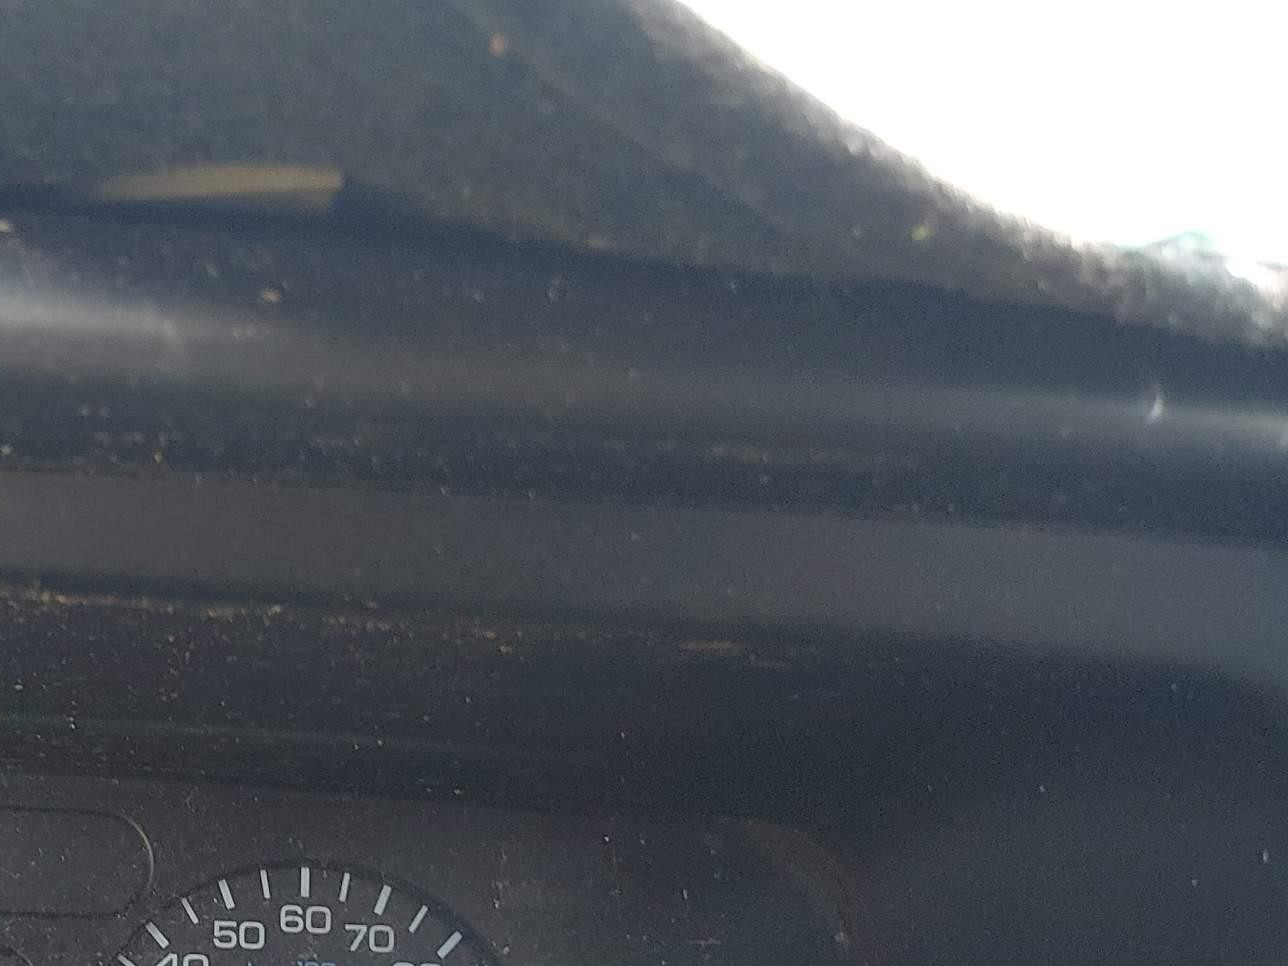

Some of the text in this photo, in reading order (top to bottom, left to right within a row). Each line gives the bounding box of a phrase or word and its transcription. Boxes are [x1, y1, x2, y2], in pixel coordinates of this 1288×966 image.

[280, 904, 332, 934] 60
[212, 920, 265, 949] 50
[344, 923, 394, 952] 70
